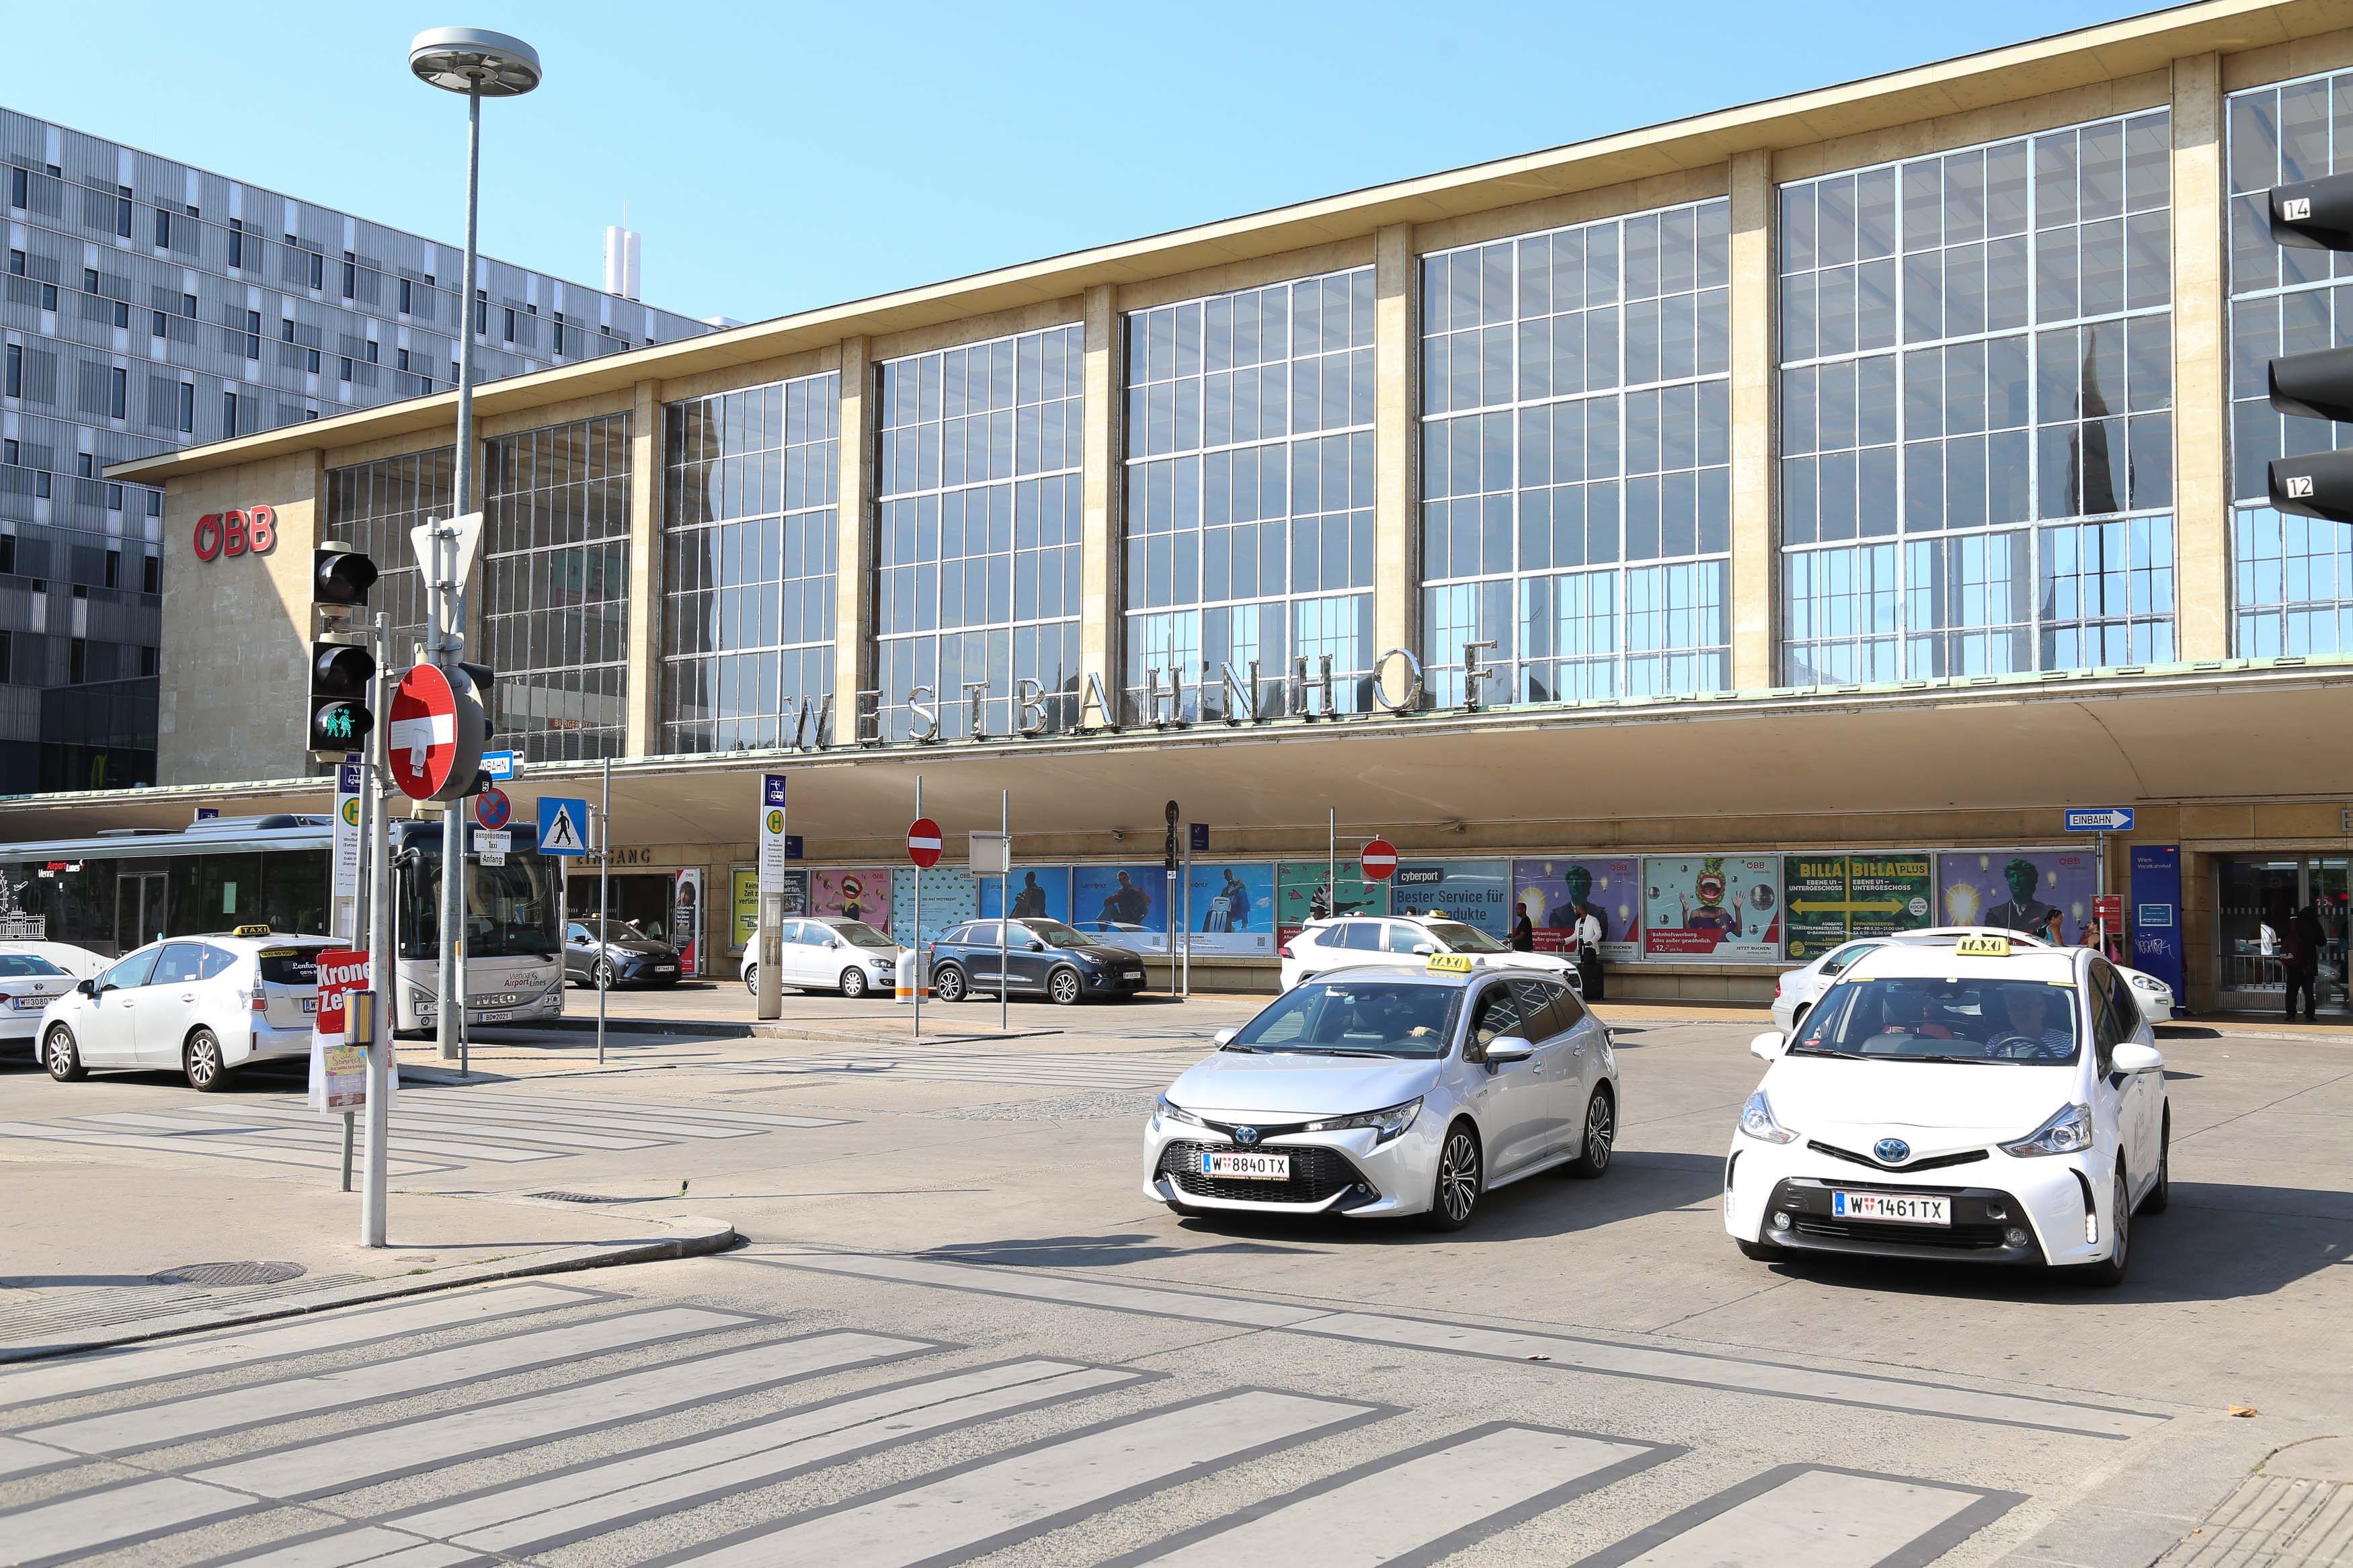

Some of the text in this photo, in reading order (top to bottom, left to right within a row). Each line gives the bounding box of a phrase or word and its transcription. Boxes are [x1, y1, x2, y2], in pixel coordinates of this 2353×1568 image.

[2287, 200, 2309, 218] 14
[2290, 478, 2313, 497] 12
[193, 504, 274, 562] ÖBB
[784, 640, 1499, 748] WESTBAHNHOF
[480, 760, 507, 772] NBAHN
[483, 783, 489, 791] 5
[2073, 815, 2112, 825] EINBAHN
[475, 832, 510, 840] ausgenommen
[483, 855, 502, 865] Anfang
[2059, 857, 2081, 865] ÖBB
[38, 869, 54, 878] Vienna
[1800, 864, 1842, 877] BILLA
[1852, 863, 1925, 876] BILLA PLUS
[1401, 870, 1438, 882] cyberport
[1397, 889, 1504, 903] Bester Service für
[1961, 940, 2001, 952] TAXI
[292, 961, 317, 969] Lenker
[1431, 956, 1463, 968] TAXI
[317, 962, 370, 987] Krone
[475, 994, 517, 1005] IVECO
